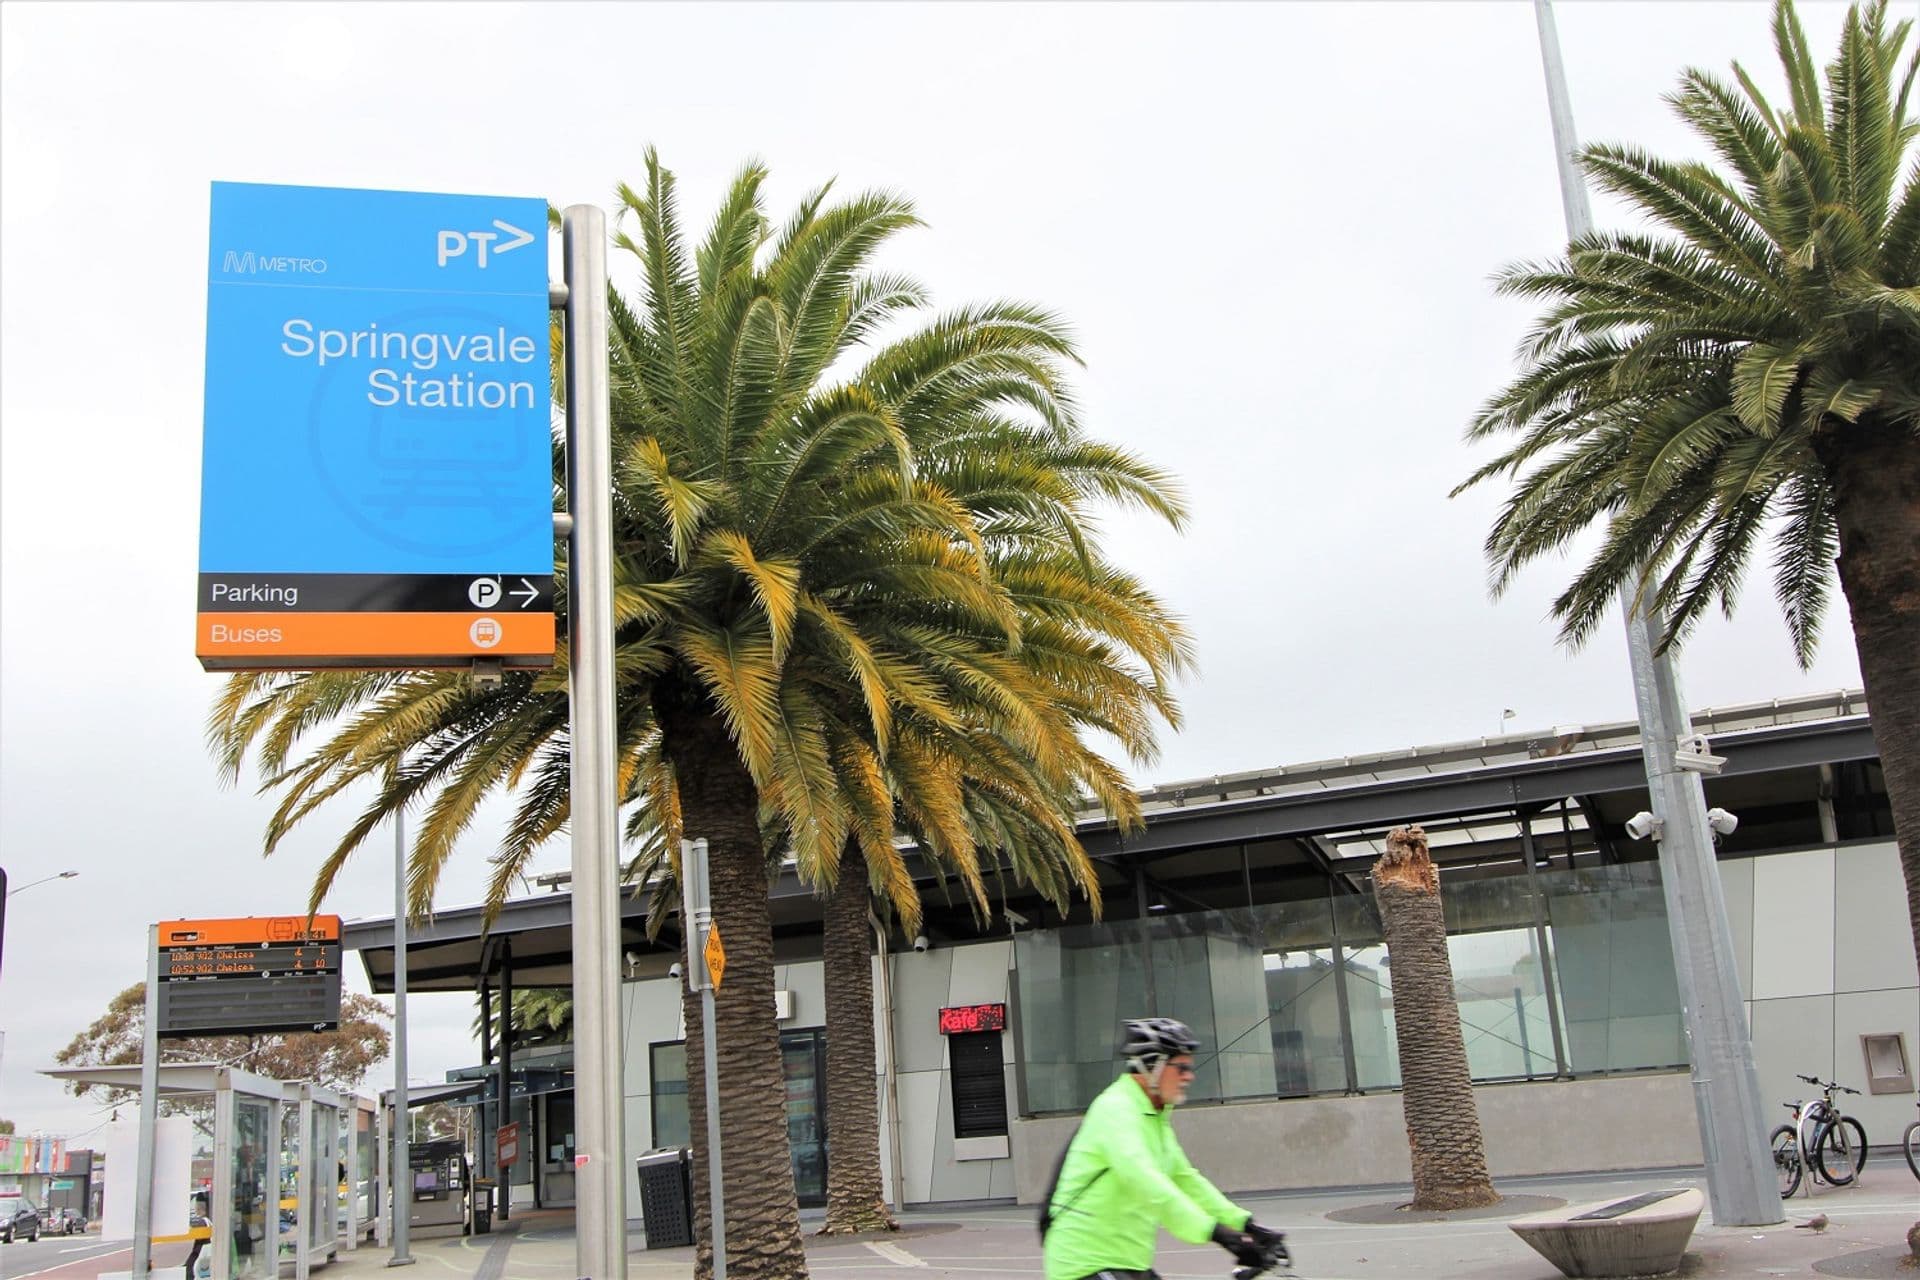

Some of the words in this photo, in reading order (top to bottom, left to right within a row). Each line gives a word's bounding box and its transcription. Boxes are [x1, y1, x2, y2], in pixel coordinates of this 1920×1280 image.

[260, 256, 327, 274] METRO
[281, 319, 536, 370] Springvale
[367, 369, 535, 409] Station
[212, 583, 298, 606] Parking
[211, 625, 282, 643] Buses
